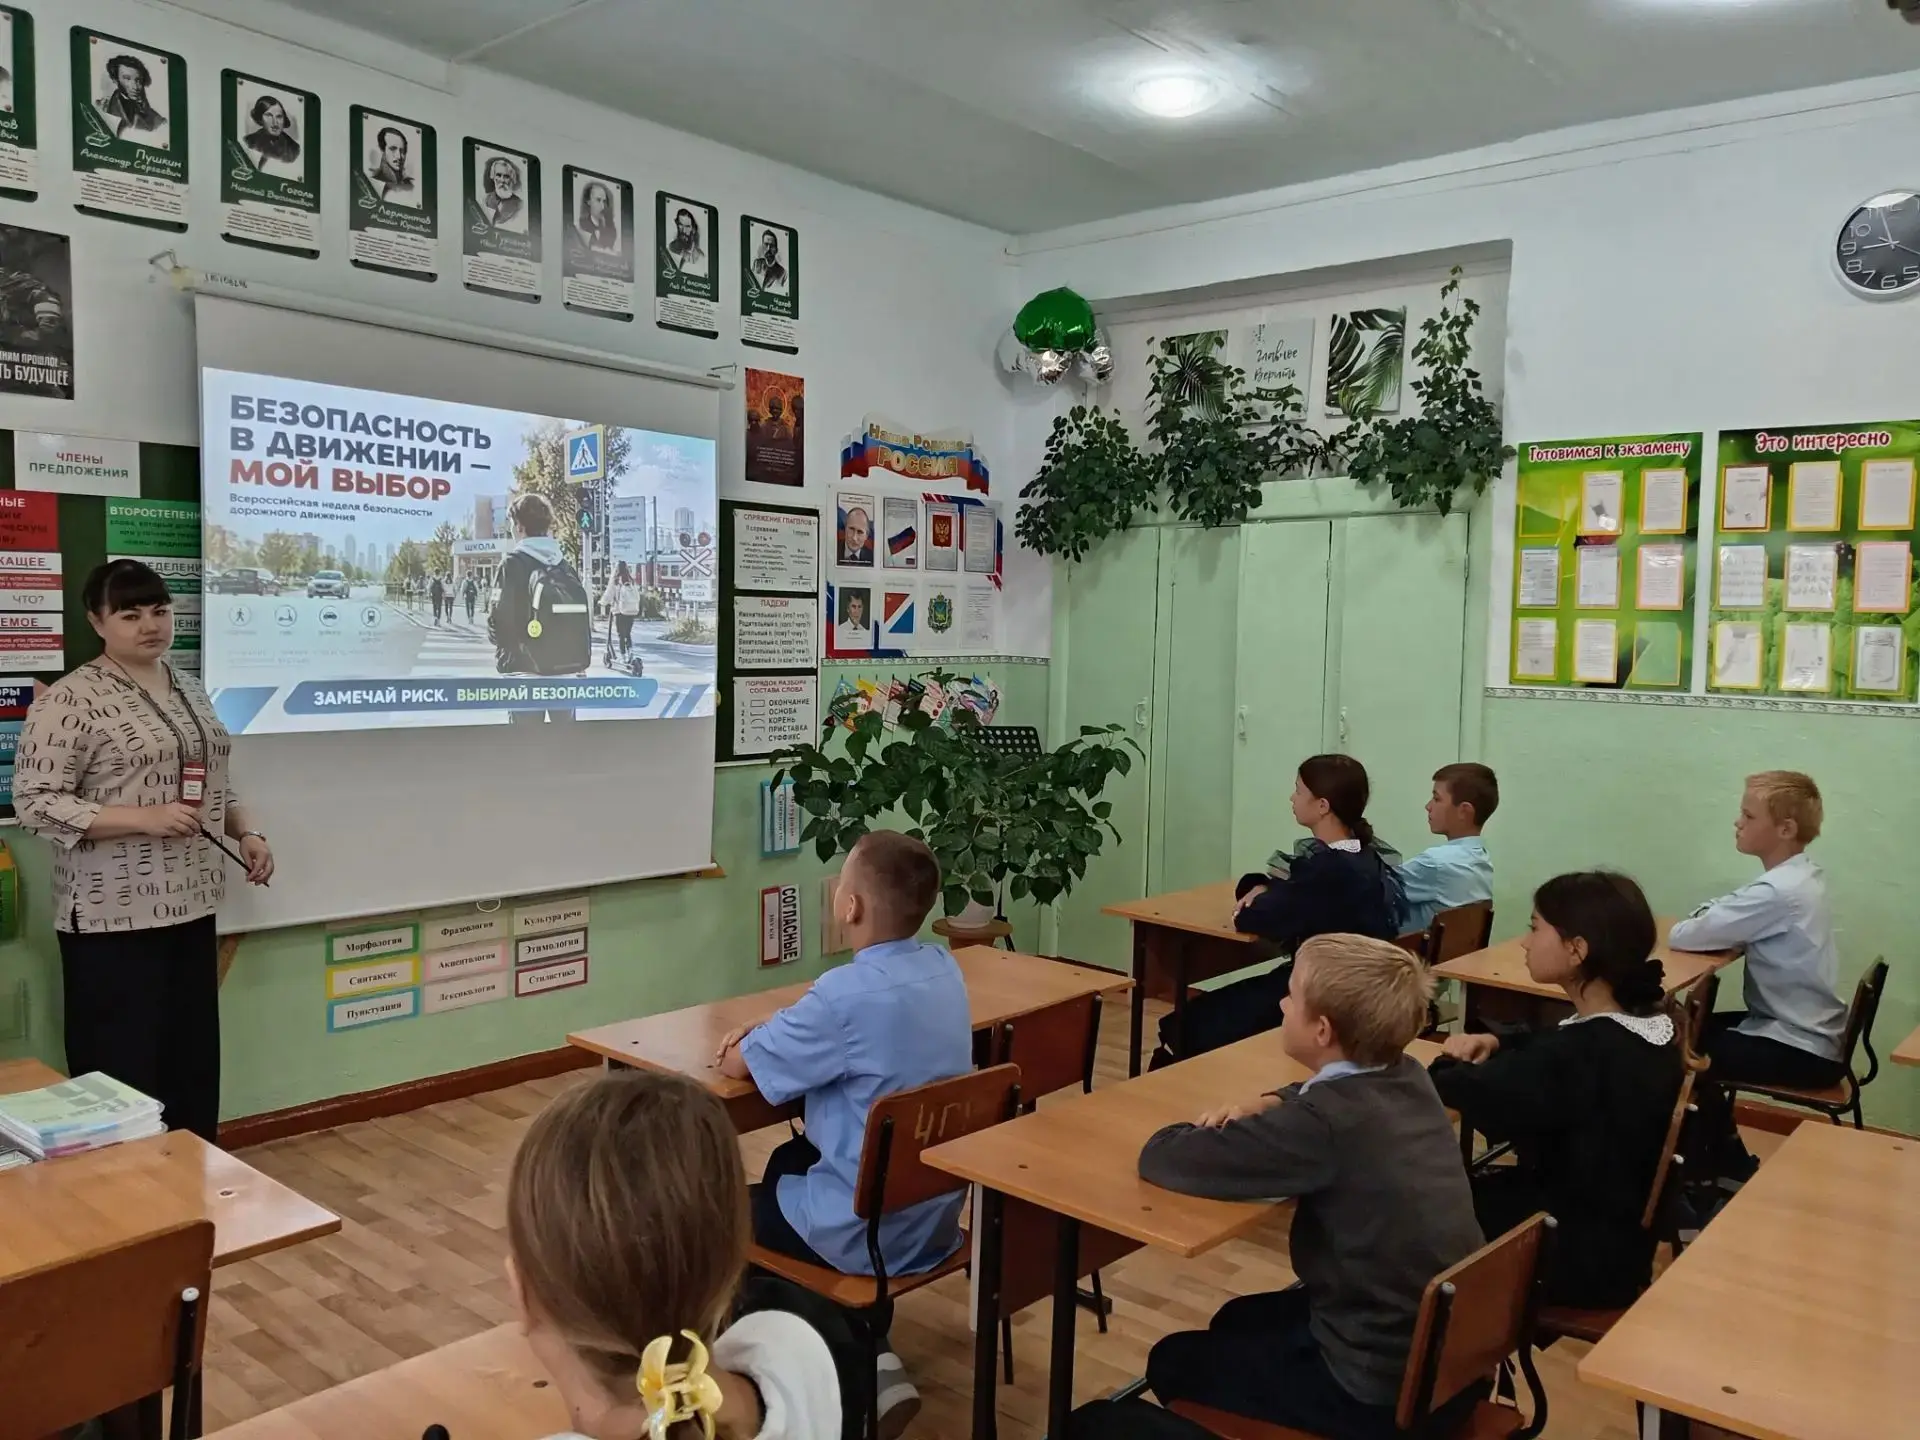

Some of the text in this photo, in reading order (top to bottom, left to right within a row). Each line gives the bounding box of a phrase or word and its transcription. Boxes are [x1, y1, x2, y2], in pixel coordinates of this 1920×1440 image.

[80, 148, 182, 178] Александр Сергеевич
[135, 149, 182, 168] Пушкин
[280, 183, 314, 199] Гоголь
[378, 205, 432, 225] Лермонтов
[1848, 223, 1872, 237] 10
[1840, 241, 1856, 256] 9
[1846, 258, 1862, 274] 8
[1902, 265, 1920, 281] 5
[1862, 269, 1876, 286] 7
[1880, 274, 1898, 289] 6
[15, 364, 69, 387] БУДУЩЕЕ
[230, 394, 492, 450] БЕЗОПАСНОСТЬ
[868, 423, 910, 447] Наша
[1756, 431, 1892, 454] Это интересно
[56, 452, 104, 465] ЧЛЕНЫ
[230, 426, 254, 452] В
[266, 431, 462, 474] ДВИЖЕНИИ
[1528, 441, 1692, 462] Готовимся к экзамену
[878, 444, 958, 476] РОССИЯ
[29, 462, 129, 478] ПРЕДЛОЖЕНИЯ
[230, 458, 452, 502] МОЙ ВЫБОР
[230, 492, 433, 517] Всероссийская неделя безопасности
[230, 506, 356, 522] дорожного движения
[464, 543, 496, 552] ШКОЛА
[12, 595, 44, 605] ЧТО?
[313, 684, 640, 707] ЗАМЕЧАЙ РИСК. ВЫБИРАЙ БЕЗОПАСНОСТЬ.
[768, 698, 810, 706] ОКОНЧАНИЕ
[768, 724, 808, 732] ПРИСТАВКА
[47, 732, 66, 748] La
[768, 733, 801, 742] СУФФИКС
[144, 768, 178, 788] Oui
[132, 843, 154, 876] Oui
[85, 872, 106, 905] Oui
[137, 882, 160, 897] Oh
[166, 880, 183, 894] La
[153, 898, 188, 920] Oui
[524, 909, 582, 927] Культура речи
[440, 920, 494, 937] Фразеология
[782, 886, 798, 960] СОГЛАСНЫЕ
[345, 936, 402, 954] Морфология
[524, 937, 580, 956] Этимология
[438, 952, 496, 970] Акцентология
[348, 970, 398, 986] Синтаксис
[528, 968, 577, 986] Стилистика
[438, 984, 496, 1002] Лексикология
[346, 1002, 402, 1020] Пунктуация
